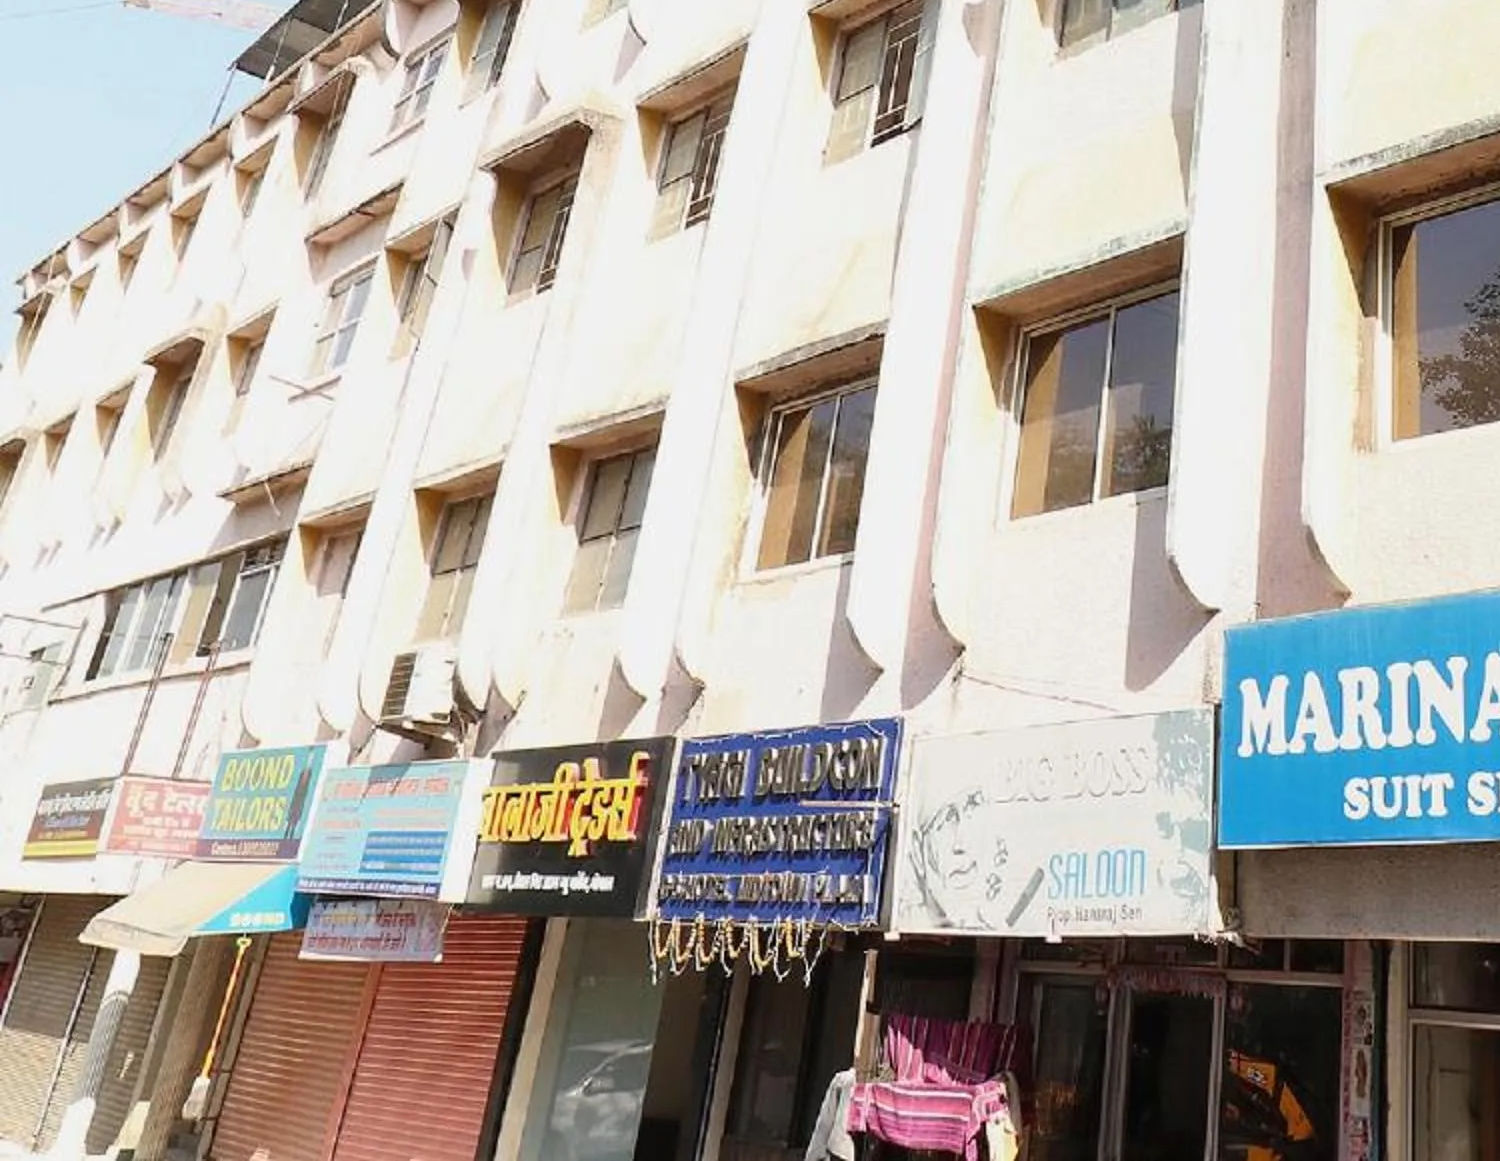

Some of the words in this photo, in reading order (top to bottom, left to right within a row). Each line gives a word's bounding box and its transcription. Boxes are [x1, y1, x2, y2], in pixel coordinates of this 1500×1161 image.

[220, 754, 296, 792] BOOND
[755, 737, 887, 797] BUILDCON
[210, 795, 288, 831] TAILORS
[1342, 770, 1455, 821] SUIT
[1047, 849, 1145, 900] SALOON
